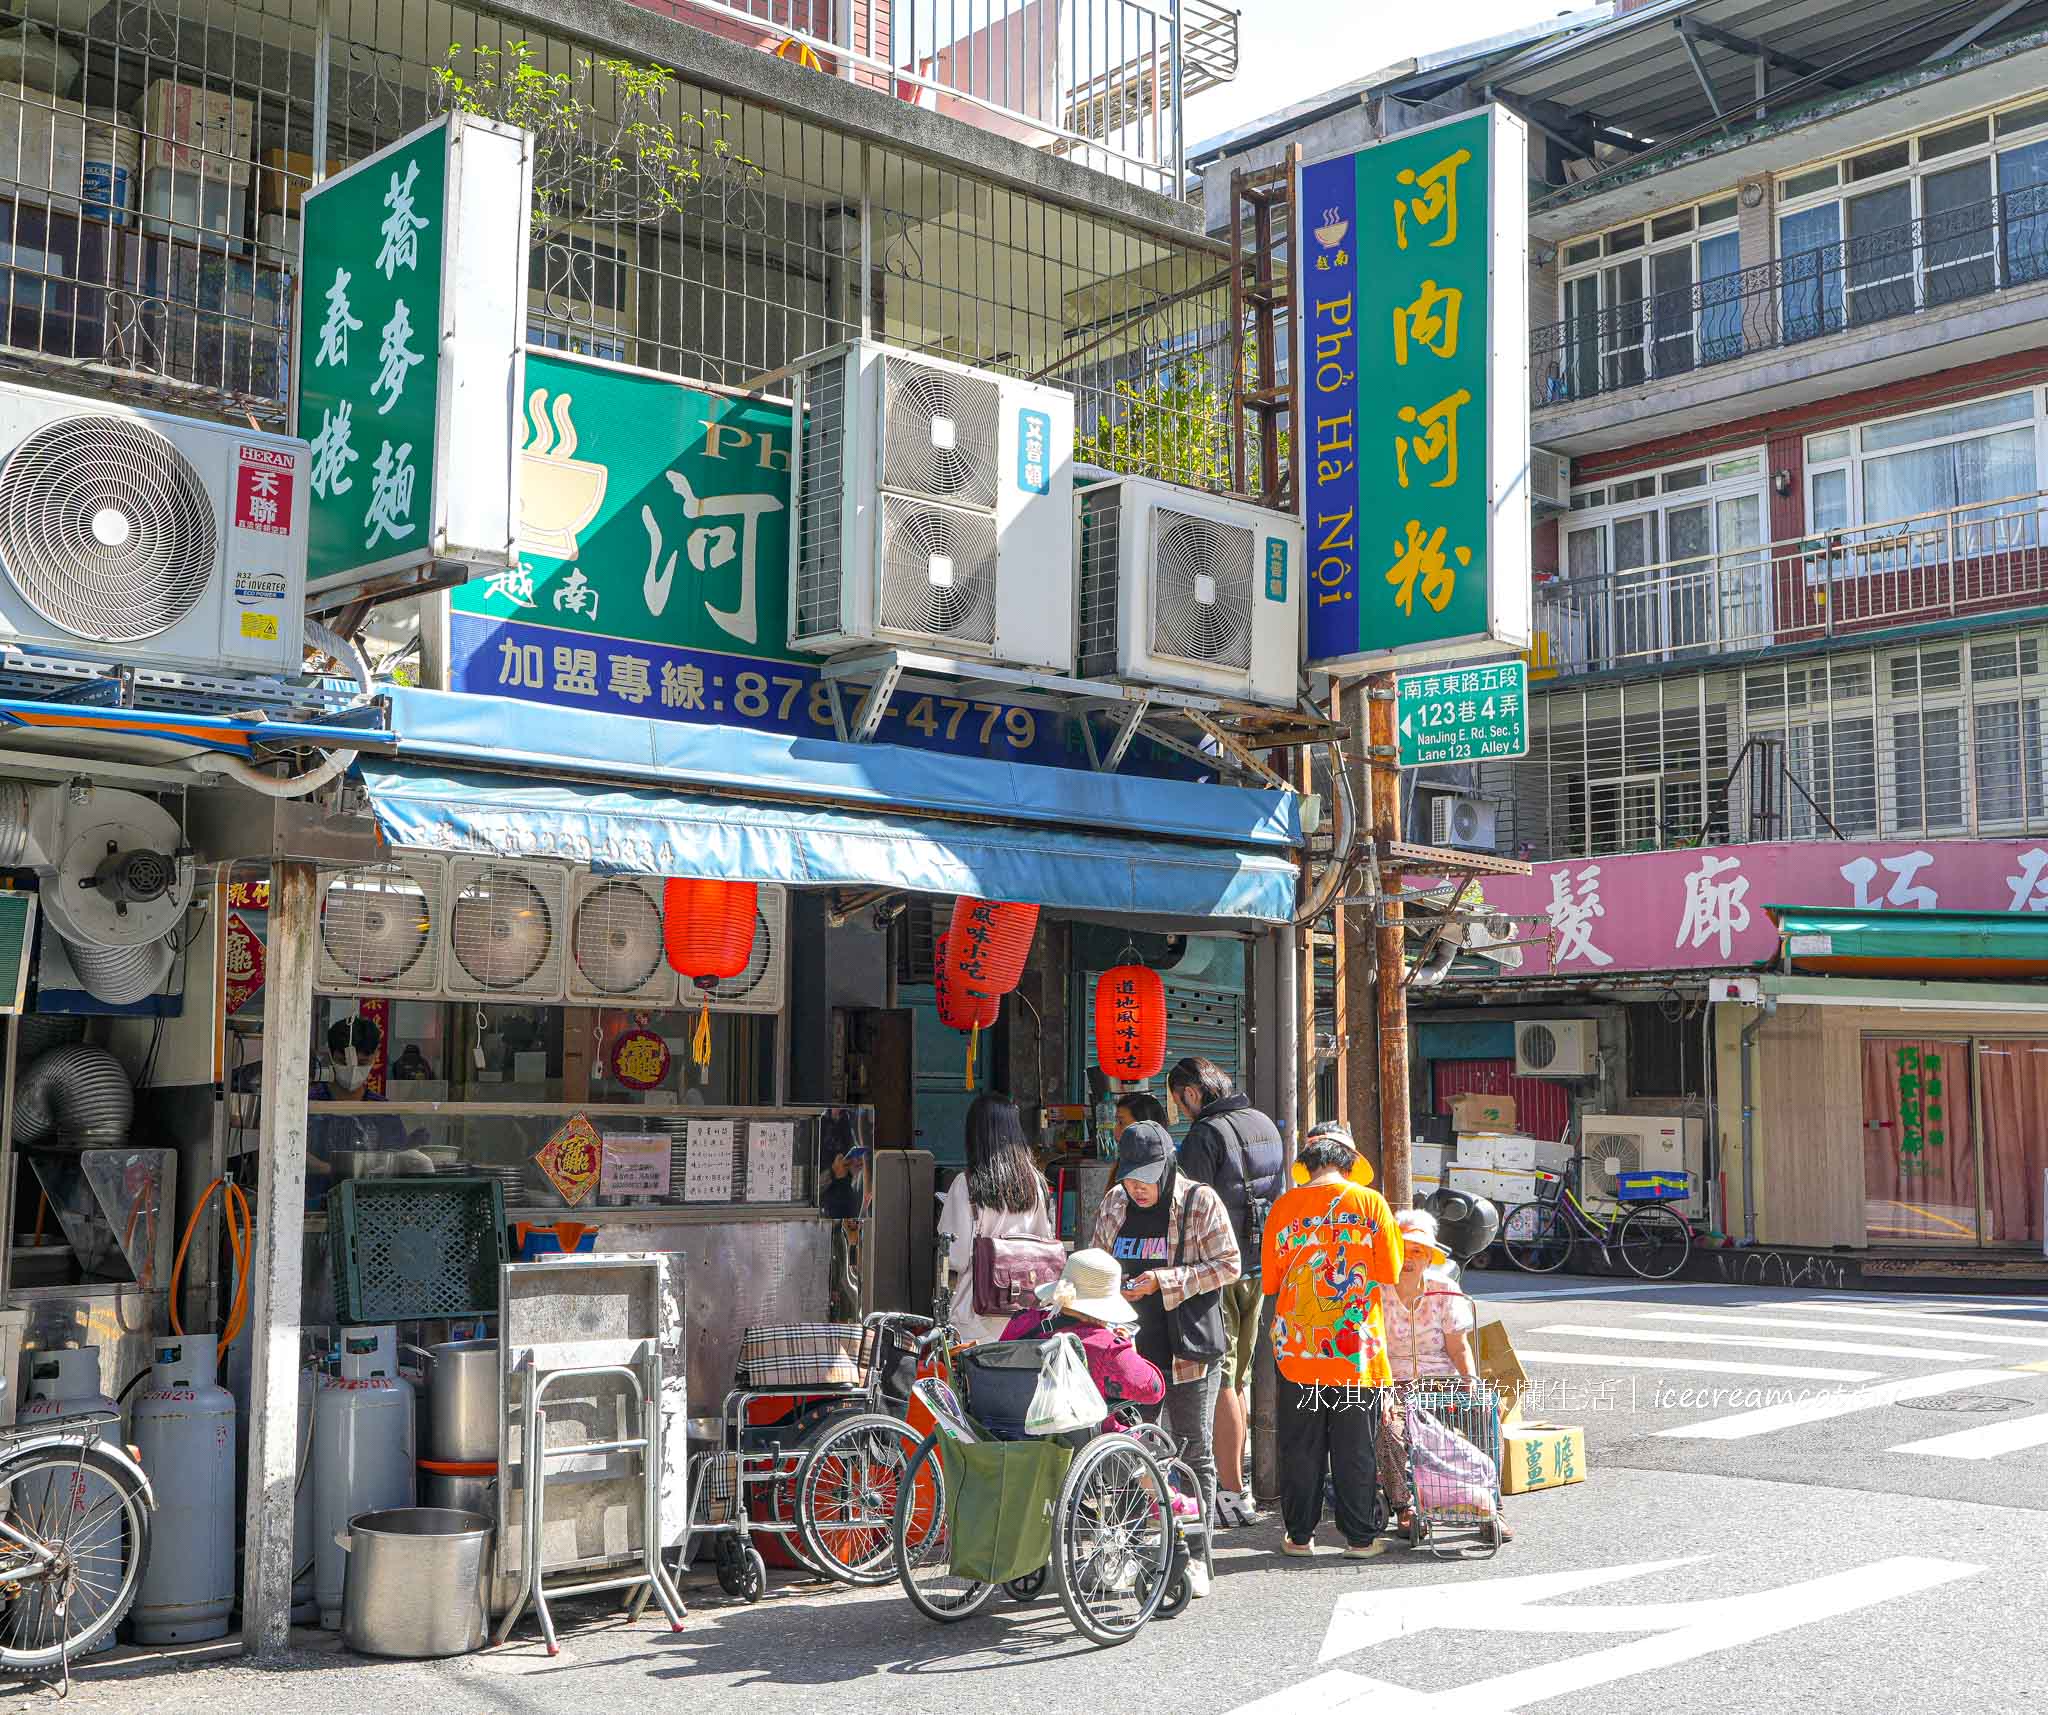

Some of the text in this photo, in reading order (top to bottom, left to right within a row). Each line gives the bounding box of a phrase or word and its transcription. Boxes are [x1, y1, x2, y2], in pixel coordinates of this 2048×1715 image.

[1316, 250, 1348, 270] 越南
[311, 267, 363, 499] 春捲
[241, 447, 294, 468] HERAN
[698, 420, 792, 473] Ph
[1316, 415, 1354, 485] Hà
[249, 471, 279, 523] 禾聯
[642, 470, 784, 645] 河
[235, 580, 286, 592] DC INVERTER
[484, 563, 598, 622] 越南
[1403, 667, 1518, 700] 南京東路五段
[1418, 738, 1520, 761] Lane 123 Alley 4
[1459, 729, 1469, 741] E.
[1471, 727, 1487, 739] Rd.
[1490, 725, 1511, 738] Sec.
[1513, 723, 1520, 735] 5
[1546, 855, 1750, 966] 髮廊
[960, 901, 1000, 980] 風味小吃
[1116, 980, 1141, 1068] 道地風味小吃
